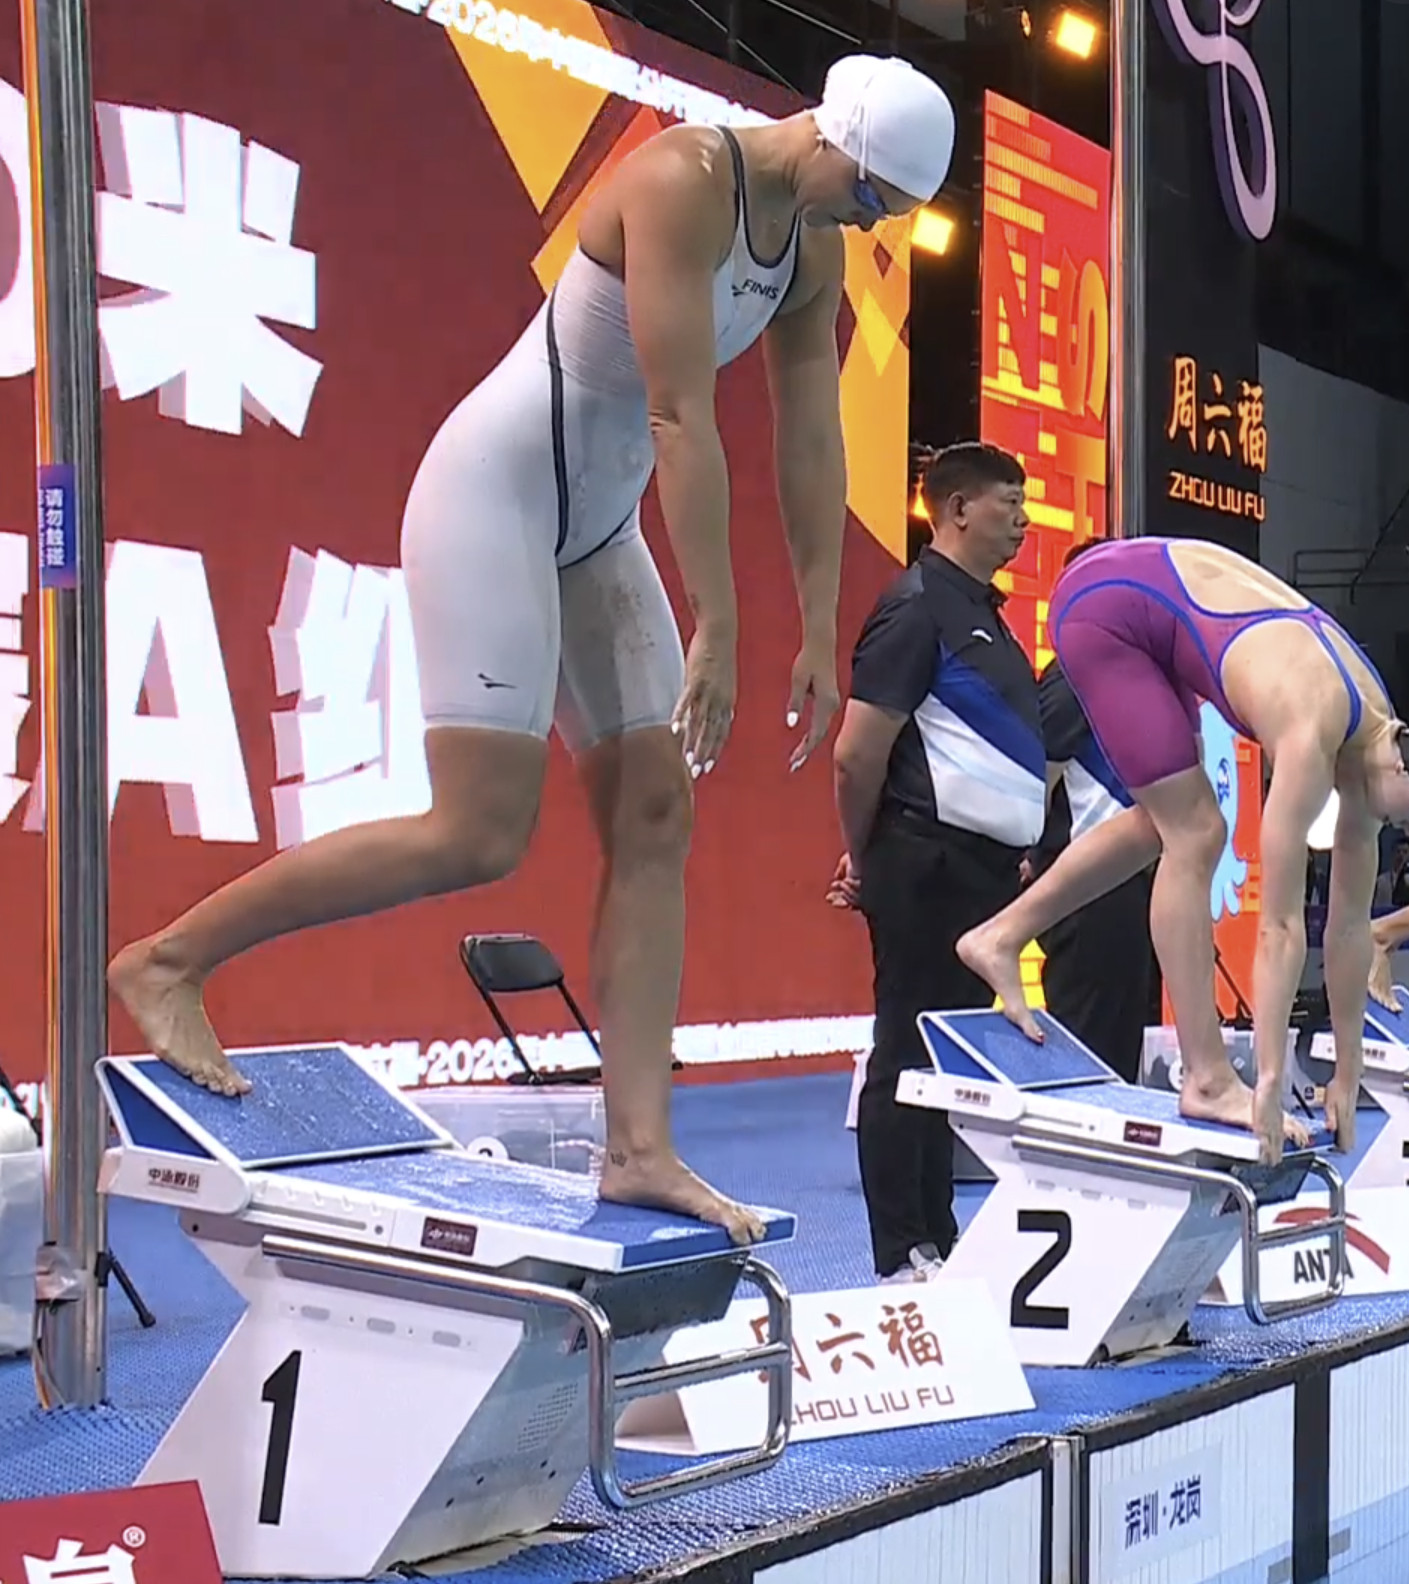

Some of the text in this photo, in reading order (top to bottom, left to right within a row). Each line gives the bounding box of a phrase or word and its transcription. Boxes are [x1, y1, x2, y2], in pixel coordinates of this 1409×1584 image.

[741, 278, 779, 300] FINIS
[1168, 355, 1269, 474] 周六福
[1169, 470, 1267, 523] ZHOU LIU FU
[1010, 1209, 1073, 1329] 2
[258, 1348, 303, 1526] 1
[789, 1384, 956, 1427] HOU LIU FU
